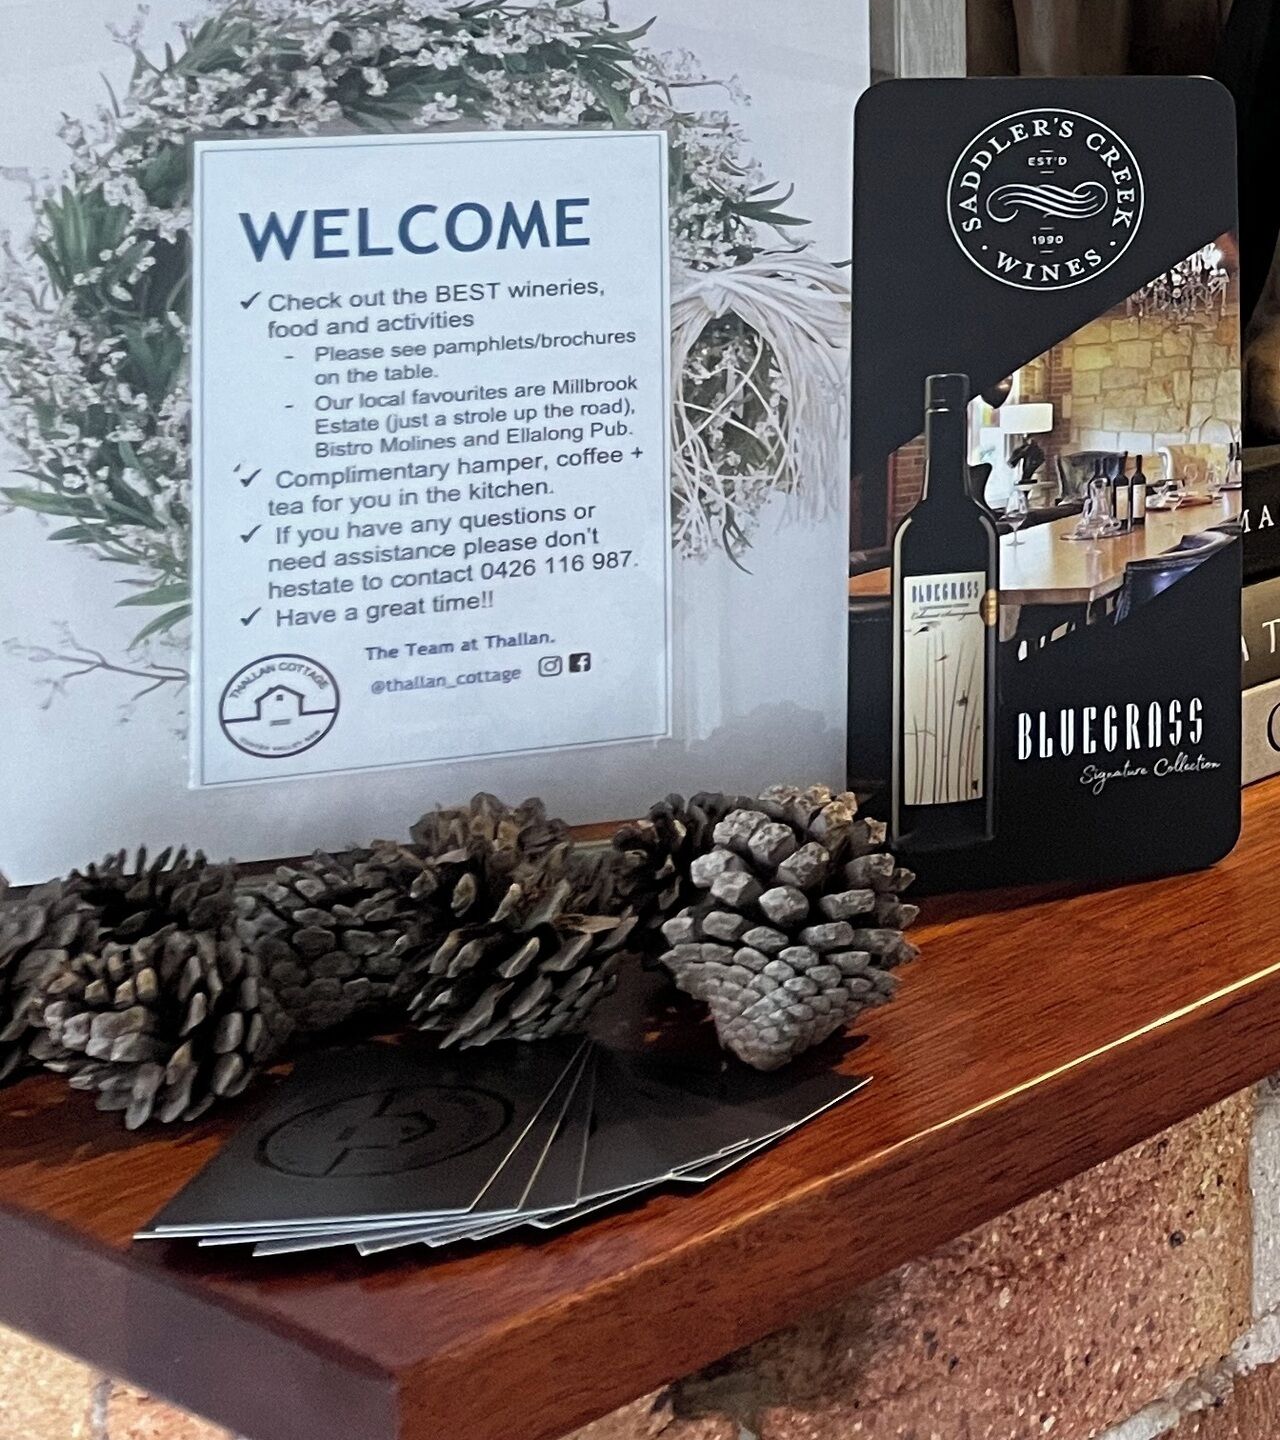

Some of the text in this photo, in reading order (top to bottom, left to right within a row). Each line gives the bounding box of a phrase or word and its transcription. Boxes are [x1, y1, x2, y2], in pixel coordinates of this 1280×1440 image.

[957, 117, 1136, 233] SADDLER'S CREEK
[1027, 156, 1068, 167] EST'D
[239, 197, 591, 262] WELCOME
[1031, 235, 1064, 245] 1990
[996, 248, 1102, 282] WINES
[268, 278, 605, 312] Check out the BEST wineries,
[268, 311, 475, 338] food and activities
[314, 330, 637, 362] Please see pamphlets/brochures
[314, 365, 439, 386] on the table.
[314, 375, 638, 411] Our local favourites are Millbrook
[314, 397, 635, 435] Estate (just a strole up the road),
[314, 421, 633, 458] Bistro Molines and Ellalong Pub.
[275, 446, 643, 489] Complimentary hamper, coffee +
[267, 480, 554, 517] tea for you in the kitchen.
[275, 505, 596, 547] If you have any questions or
[268, 527, 600, 572] need assistance please don't
[268, 550, 639, 599] hestate to contact 0426 116 987.
[912, 581, 979, 603] BLUEGRASS
[276, 590, 494, 627] Have a great time!!
[365, 631, 556, 661] The Team at Thallan.
[229, 661, 330, 699] THALLAN COTTAGE
[370, 667, 522, 695] @thallan_cottage
[1018, 697, 1203, 760] BLUEGRASS
[1079, 751, 1221, 795] Signature Collection
